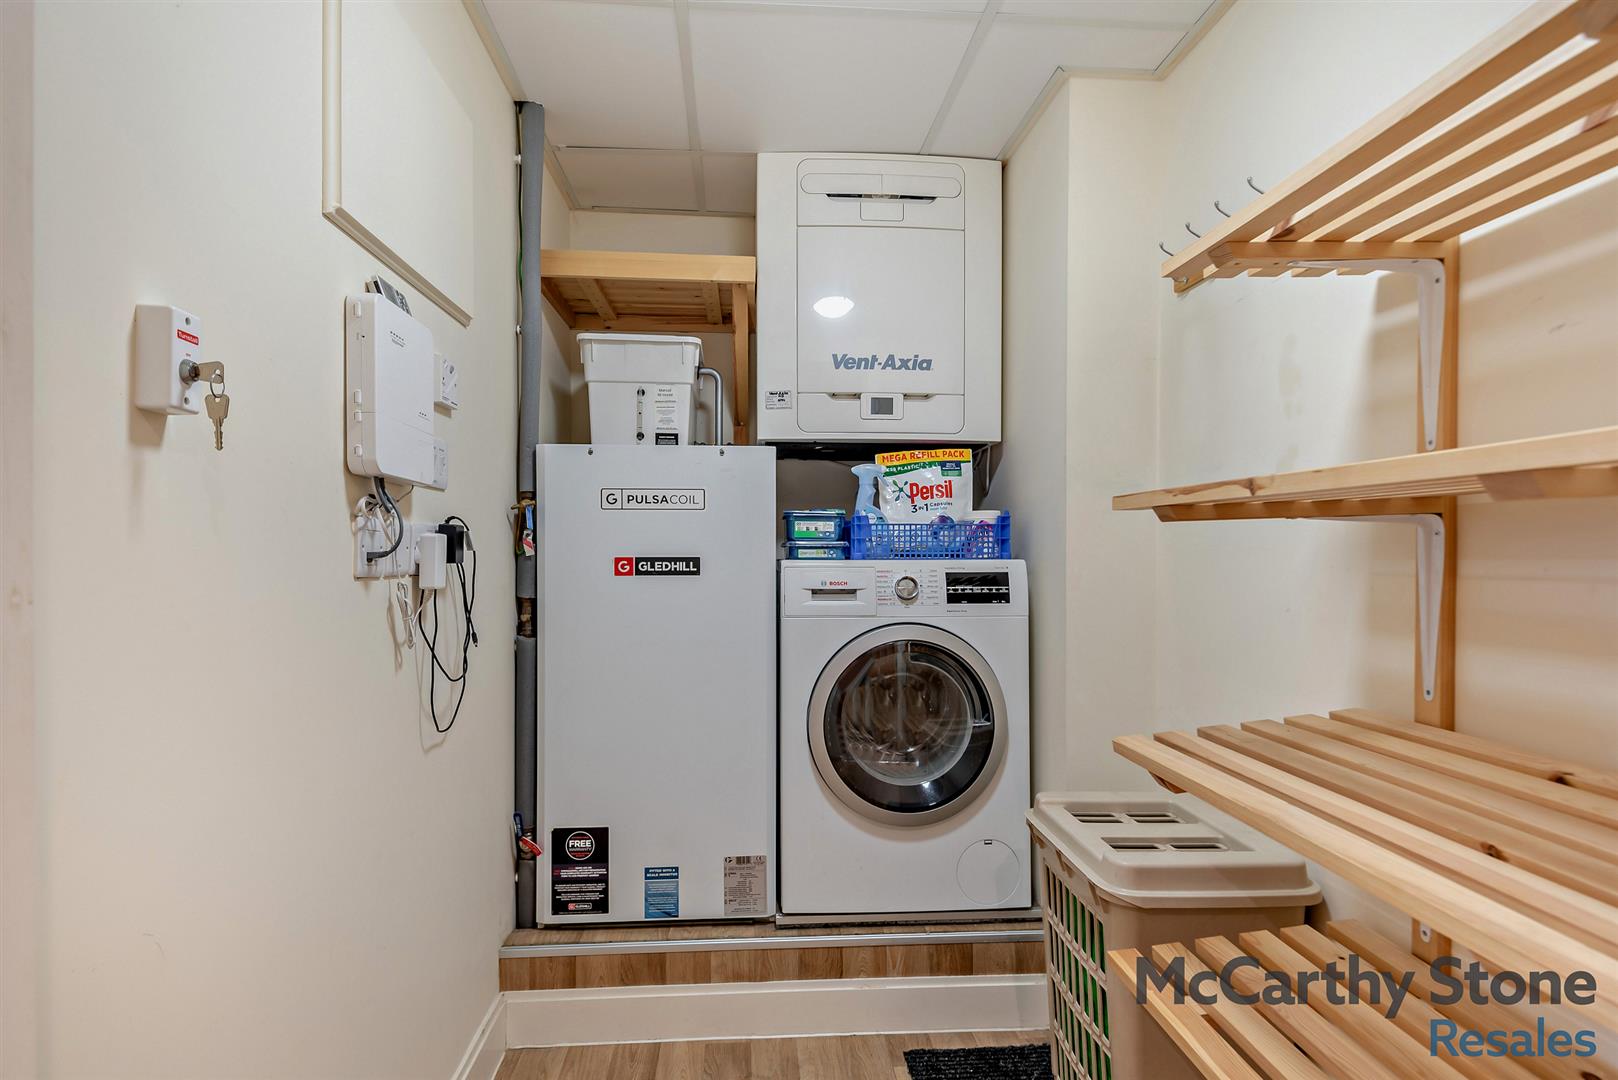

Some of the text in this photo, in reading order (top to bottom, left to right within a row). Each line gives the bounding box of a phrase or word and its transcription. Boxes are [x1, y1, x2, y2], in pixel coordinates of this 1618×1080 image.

[832, 353, 933, 371] Vent-Axia
[882, 450, 965, 463] MEGA REFILL PACK
[909, 480, 953, 504] Persil
[606, 493, 700, 505] G PULSACOIL
[617, 560, 697, 573] G GLEDHILL
[569, 839, 592, 848] FREE
